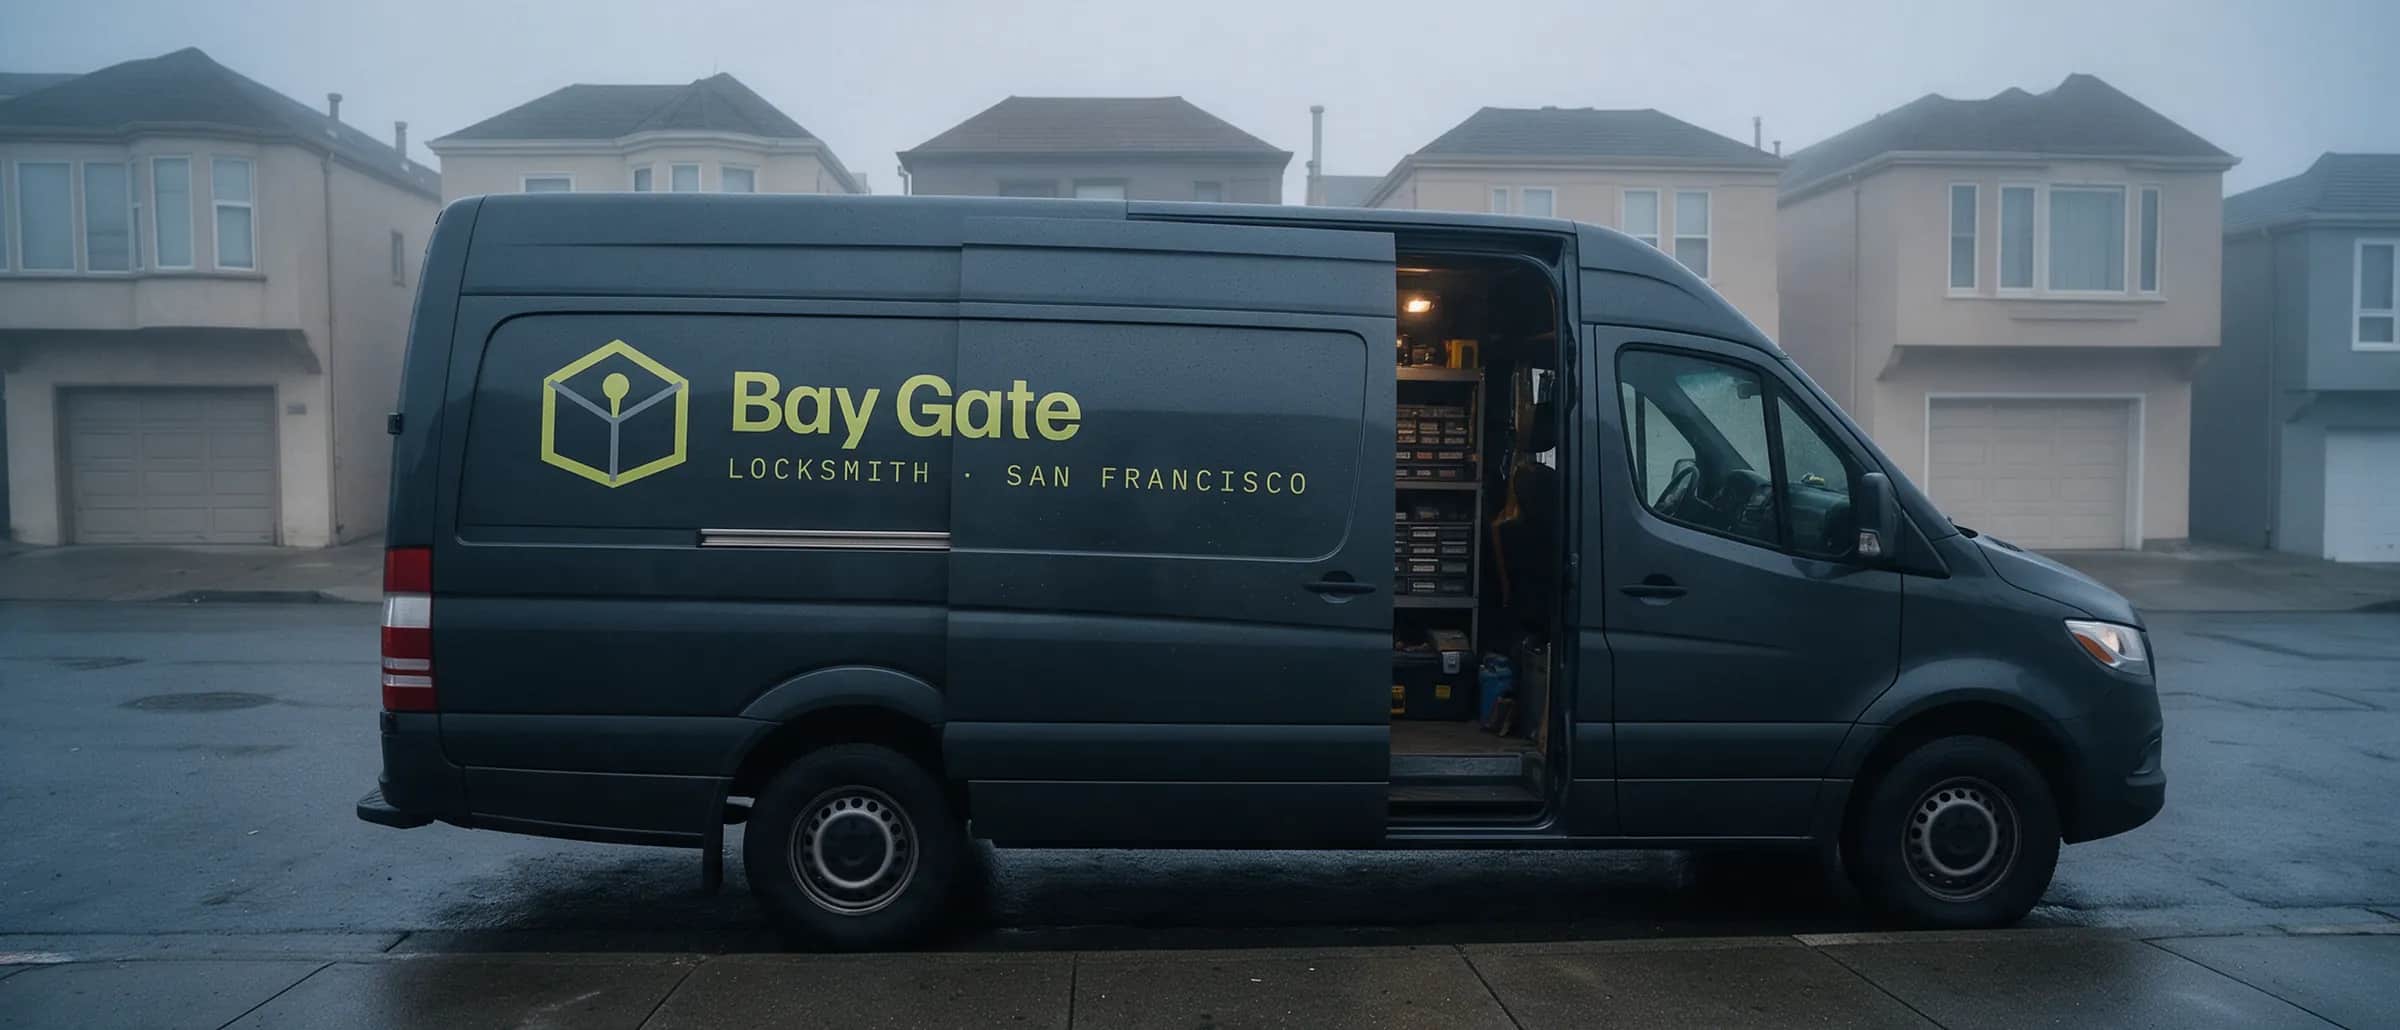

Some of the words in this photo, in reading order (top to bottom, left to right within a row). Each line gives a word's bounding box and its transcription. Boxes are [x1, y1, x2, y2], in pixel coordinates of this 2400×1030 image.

[732, 371, 881, 450] Bay
[896, 374, 1081, 441] Gate
[729, 457, 929, 483] LOCKSMITH
[1007, 464, 1071, 488] SAN
[1102, 467, 1306, 495] FRANCISCO
